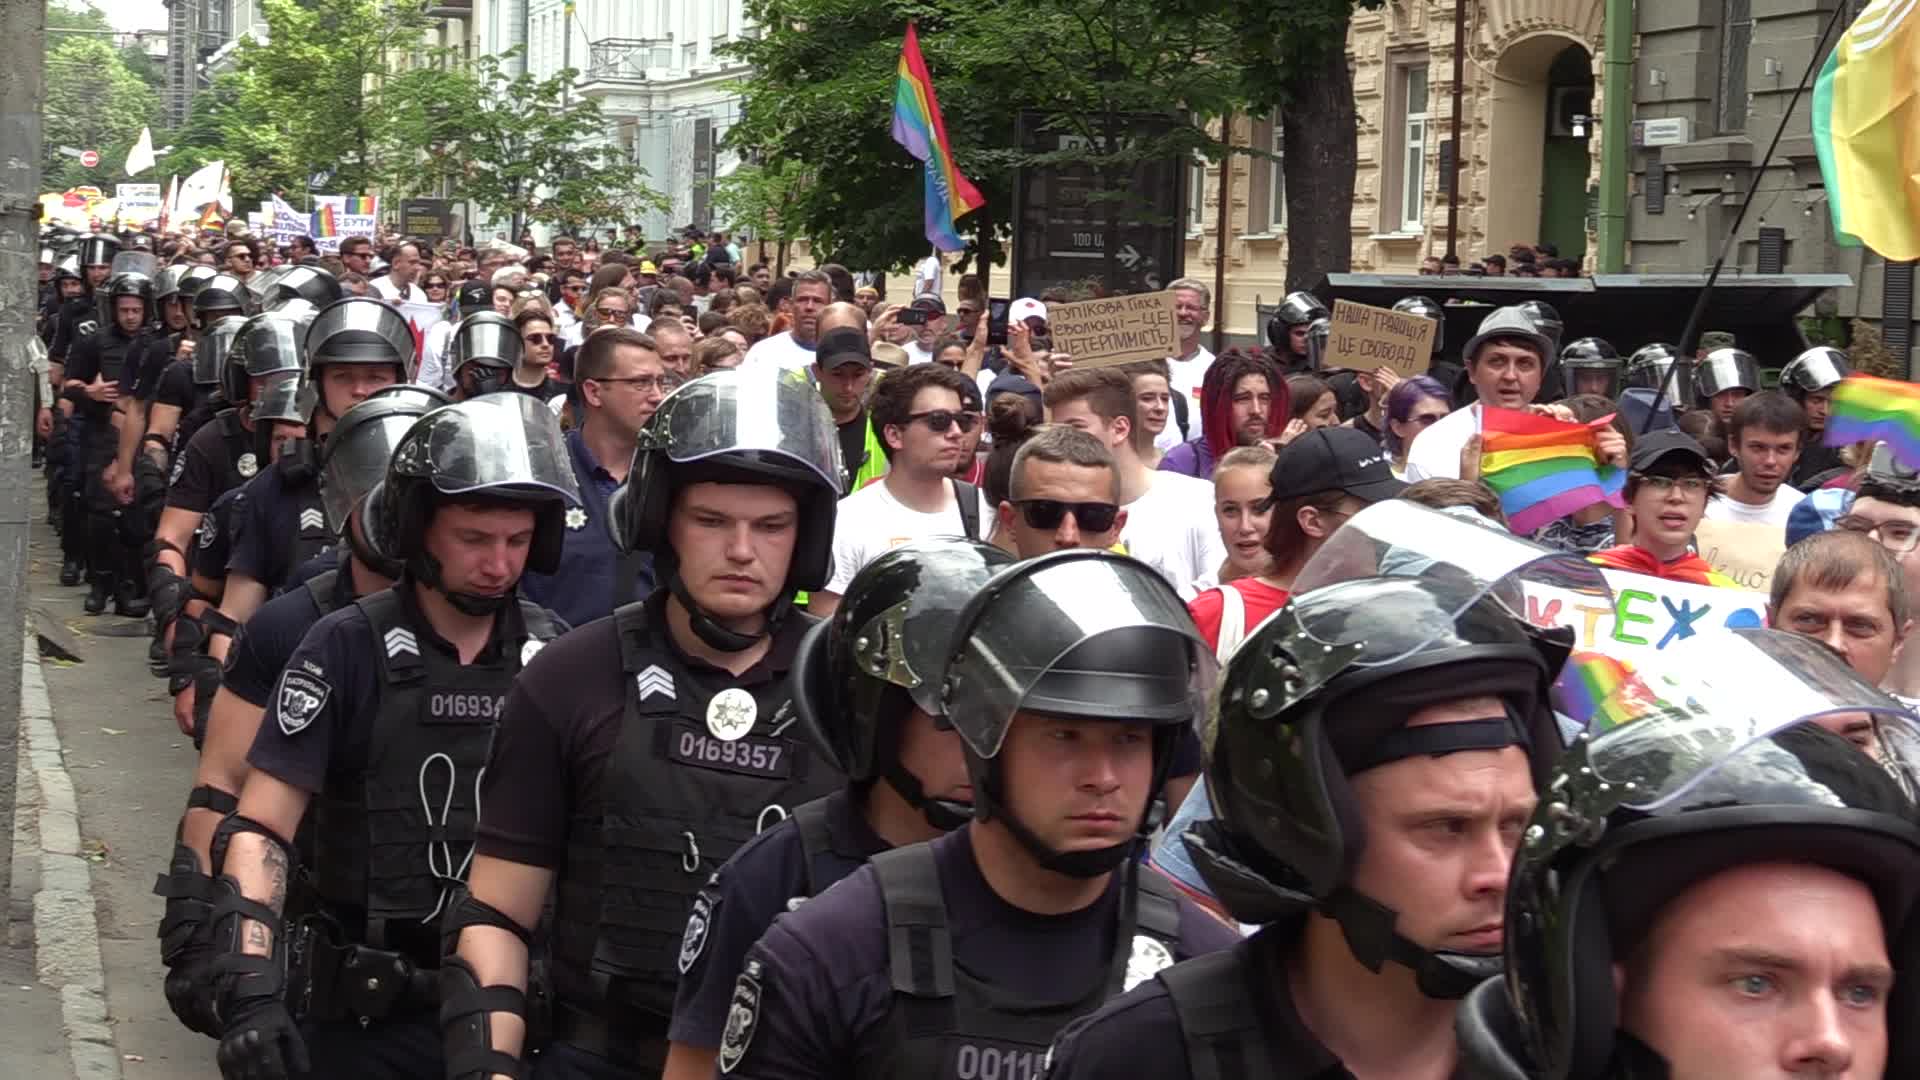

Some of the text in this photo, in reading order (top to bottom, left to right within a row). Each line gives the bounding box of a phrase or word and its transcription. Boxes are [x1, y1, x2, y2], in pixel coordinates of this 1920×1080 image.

[1072, 232, 1092, 247] 100
[1055, 301, 1125, 321] ТУПІКОВА
[1335, 303, 1429, 343] НАША ТРАДИЦІЯ
[1359, 339, 1416, 369] СВОБОДА
[680, 731, 782, 771] 0169357
